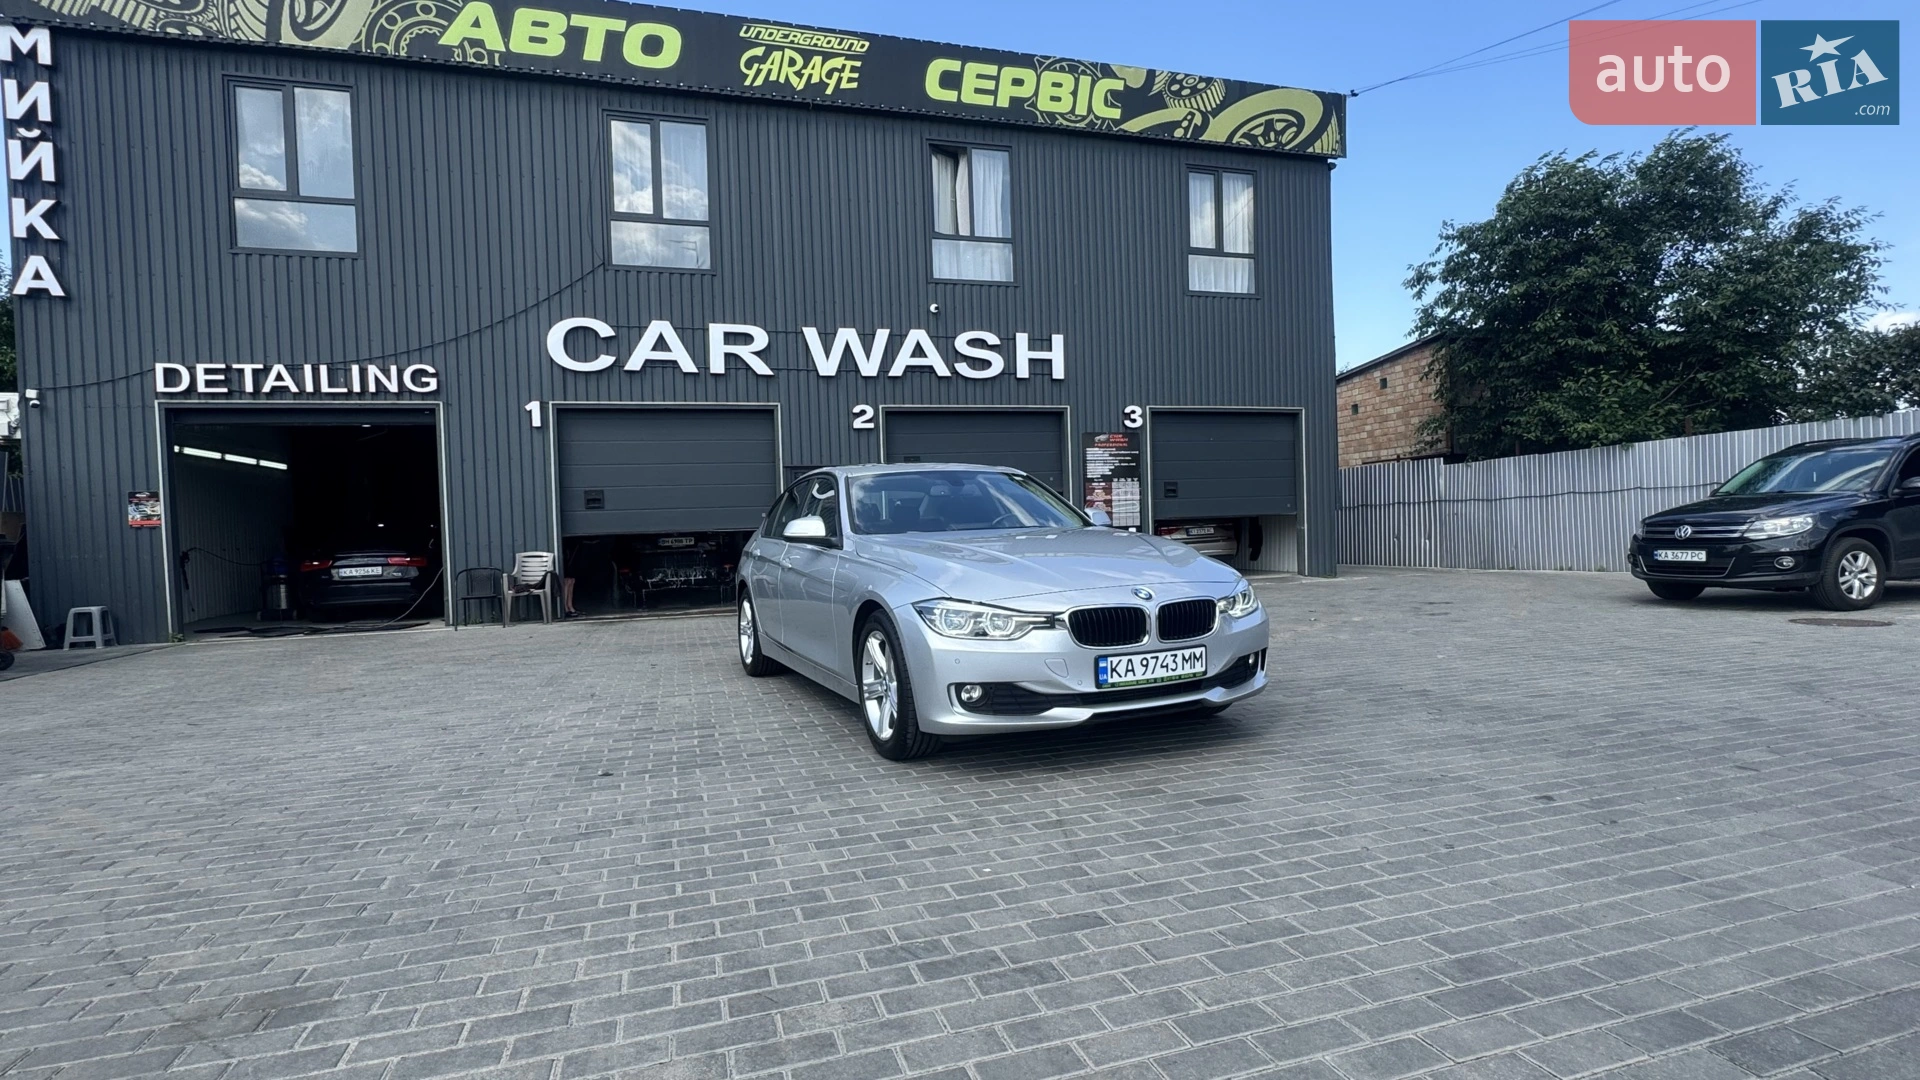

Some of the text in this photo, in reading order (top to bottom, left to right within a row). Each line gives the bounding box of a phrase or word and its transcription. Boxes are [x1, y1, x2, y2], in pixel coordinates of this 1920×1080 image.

[438, 1, 682, 69] АВТО
[738, 24, 870, 52] UNDERGROUND
[739, 46, 862, 94] GARAGE
[925, 58, 1126, 119] СЕРВІС
[0, 25, 67, 296] МИЙКА
[547, 317, 1065, 380] CAR WASH
[155, 362, 438, 393] DETAILING
[524, 401, 542, 428] 1
[852, 405, 875, 430] 2
[1123, 405, 1144, 428] 3
[1658, 551, 1703, 560] KA 3677 PC
[1110, 649, 1204, 679] KA 9743 MM
